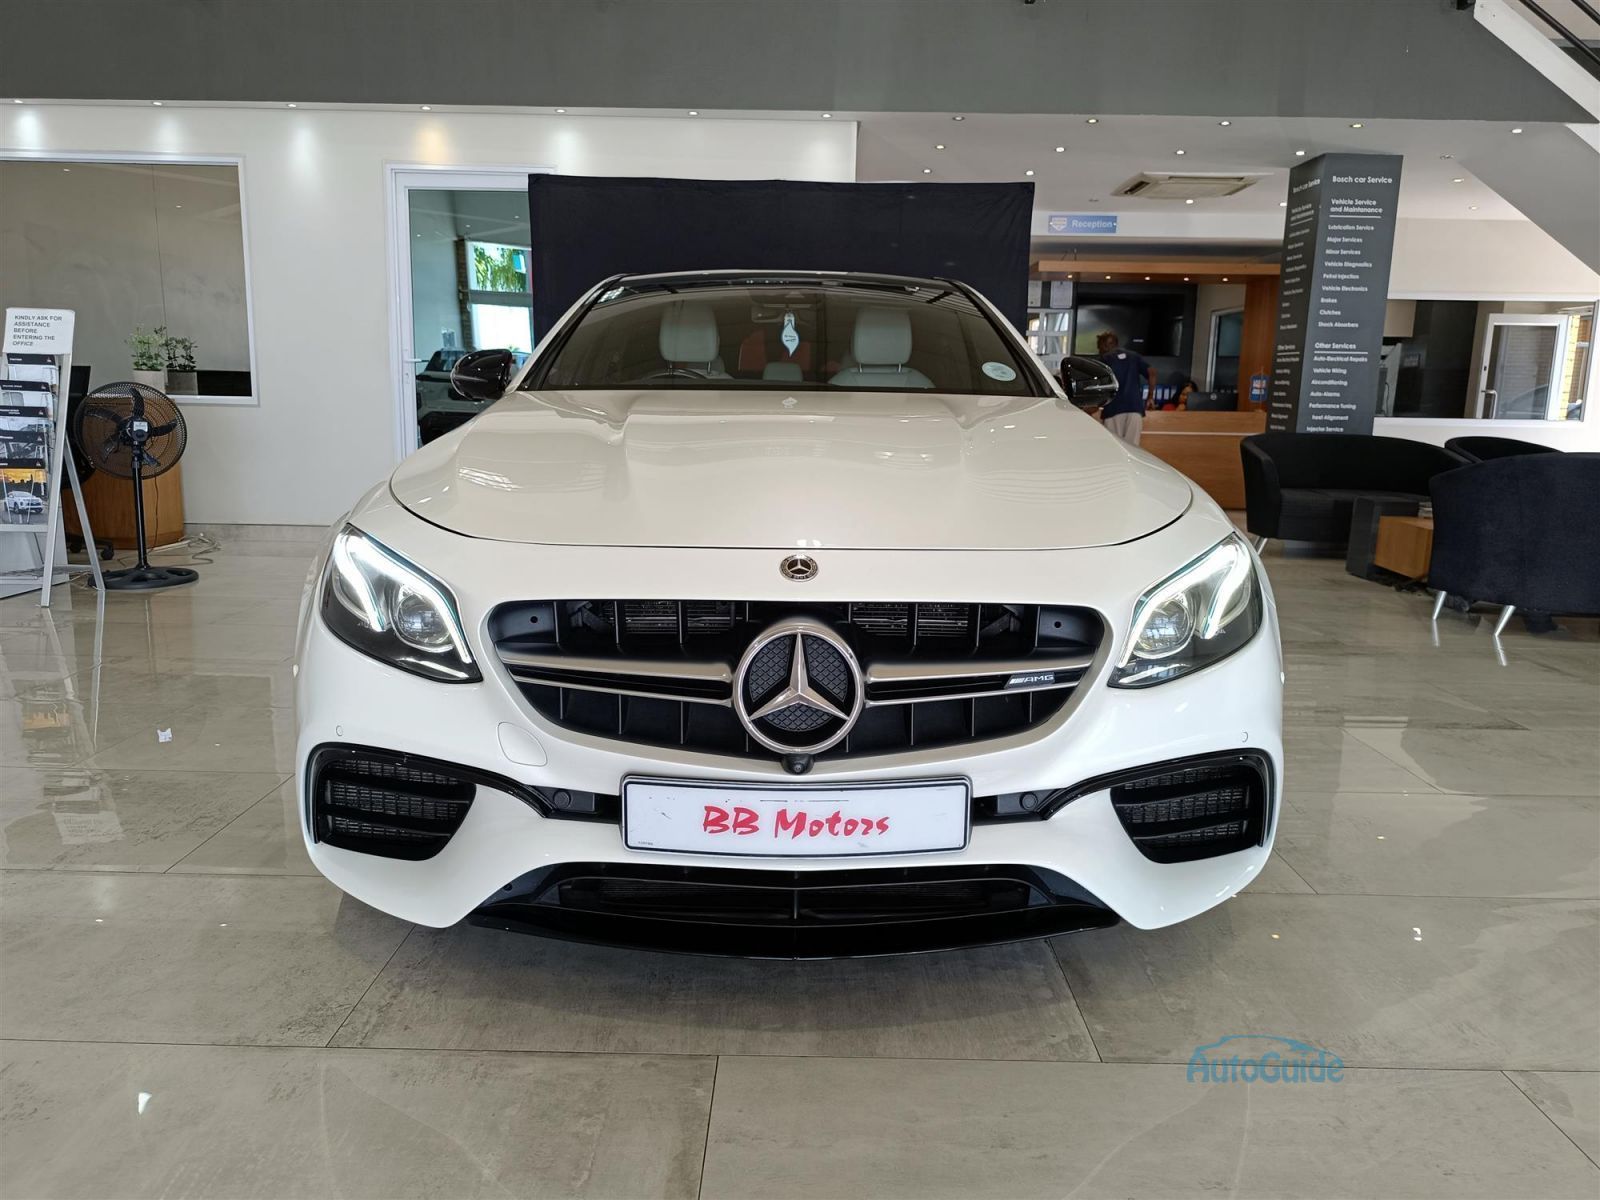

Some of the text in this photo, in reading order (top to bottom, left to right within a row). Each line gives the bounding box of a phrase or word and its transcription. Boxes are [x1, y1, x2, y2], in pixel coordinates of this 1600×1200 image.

[1332, 175, 1353, 183] Bosch
[1367, 176, 1393, 184] Service
[1071, 219, 1113, 229] Reception
[1023, 674, 1054, 683] AMG
[702, 805, 890, 840] BB Motors
